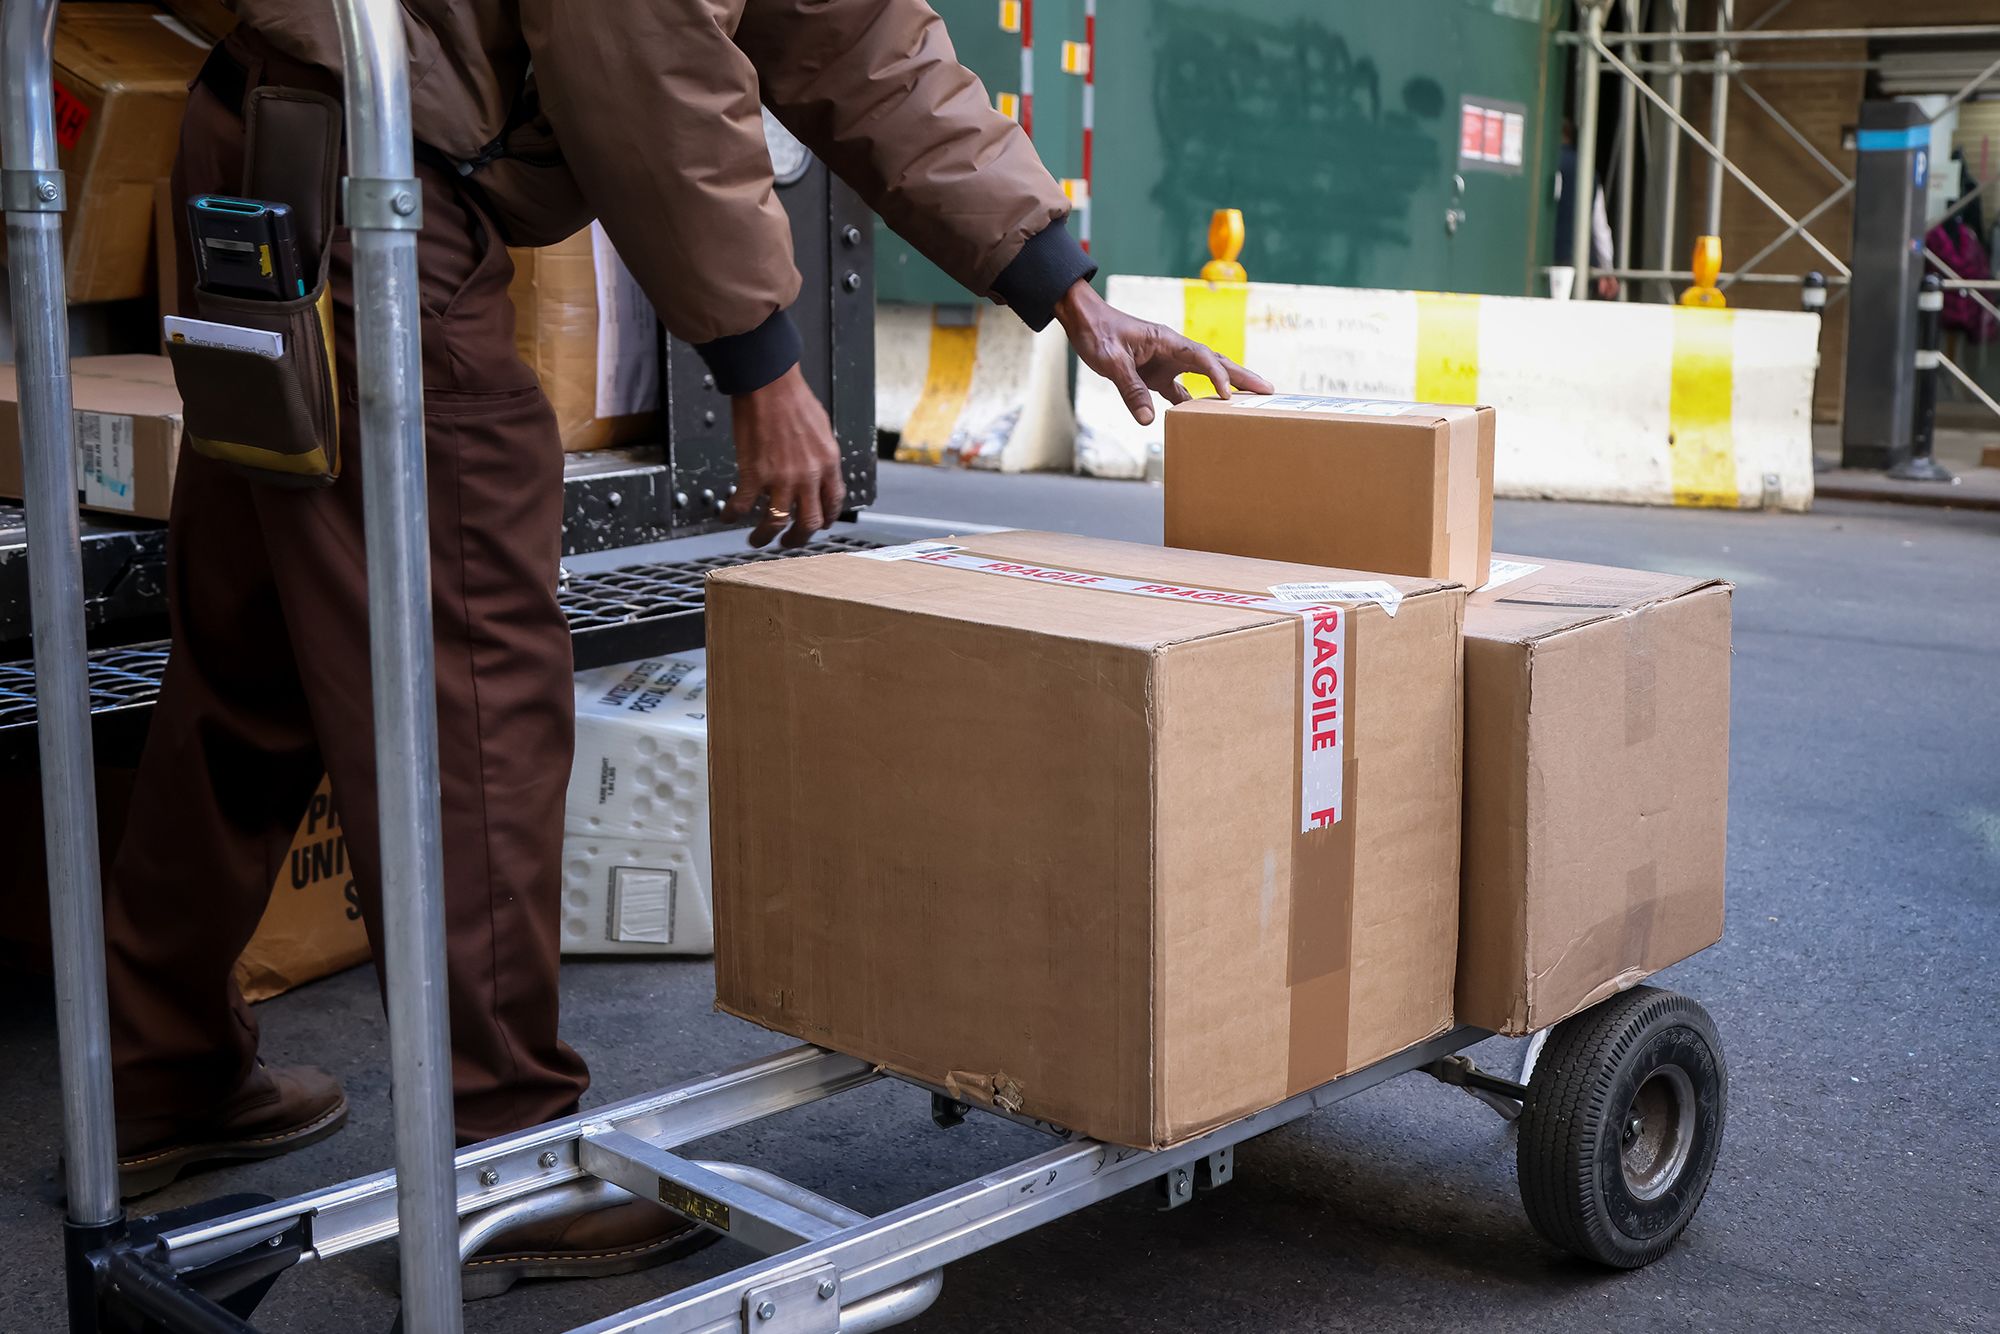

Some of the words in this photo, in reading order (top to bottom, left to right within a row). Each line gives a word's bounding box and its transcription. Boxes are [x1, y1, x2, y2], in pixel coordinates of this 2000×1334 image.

[628, 687, 672, 713] POSTAL
[979, 561, 1105, 585] FRAGILE
[1132, 584, 1270, 605] FRAGILE
[1297, 605, 1338, 752] FRAGILE
